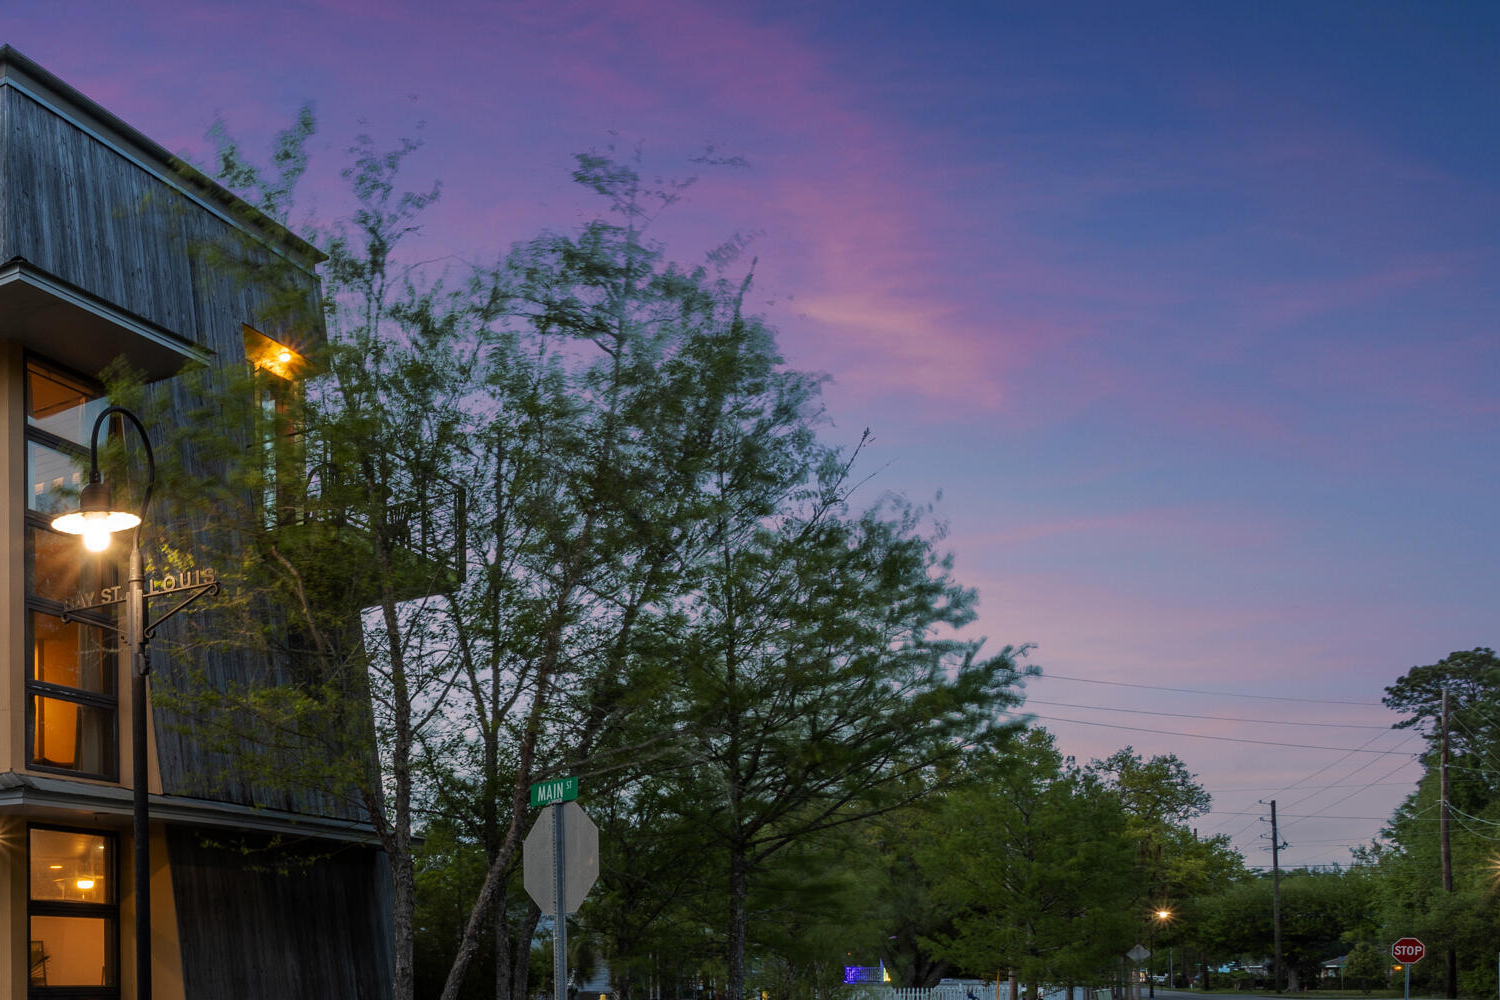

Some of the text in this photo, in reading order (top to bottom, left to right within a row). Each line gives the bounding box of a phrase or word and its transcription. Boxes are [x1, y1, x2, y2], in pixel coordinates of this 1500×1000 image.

[149, 567, 215, 594] LOUIS
[537, 780, 573, 802] MAIN ST
[1394, 945, 1422, 956] STOP
